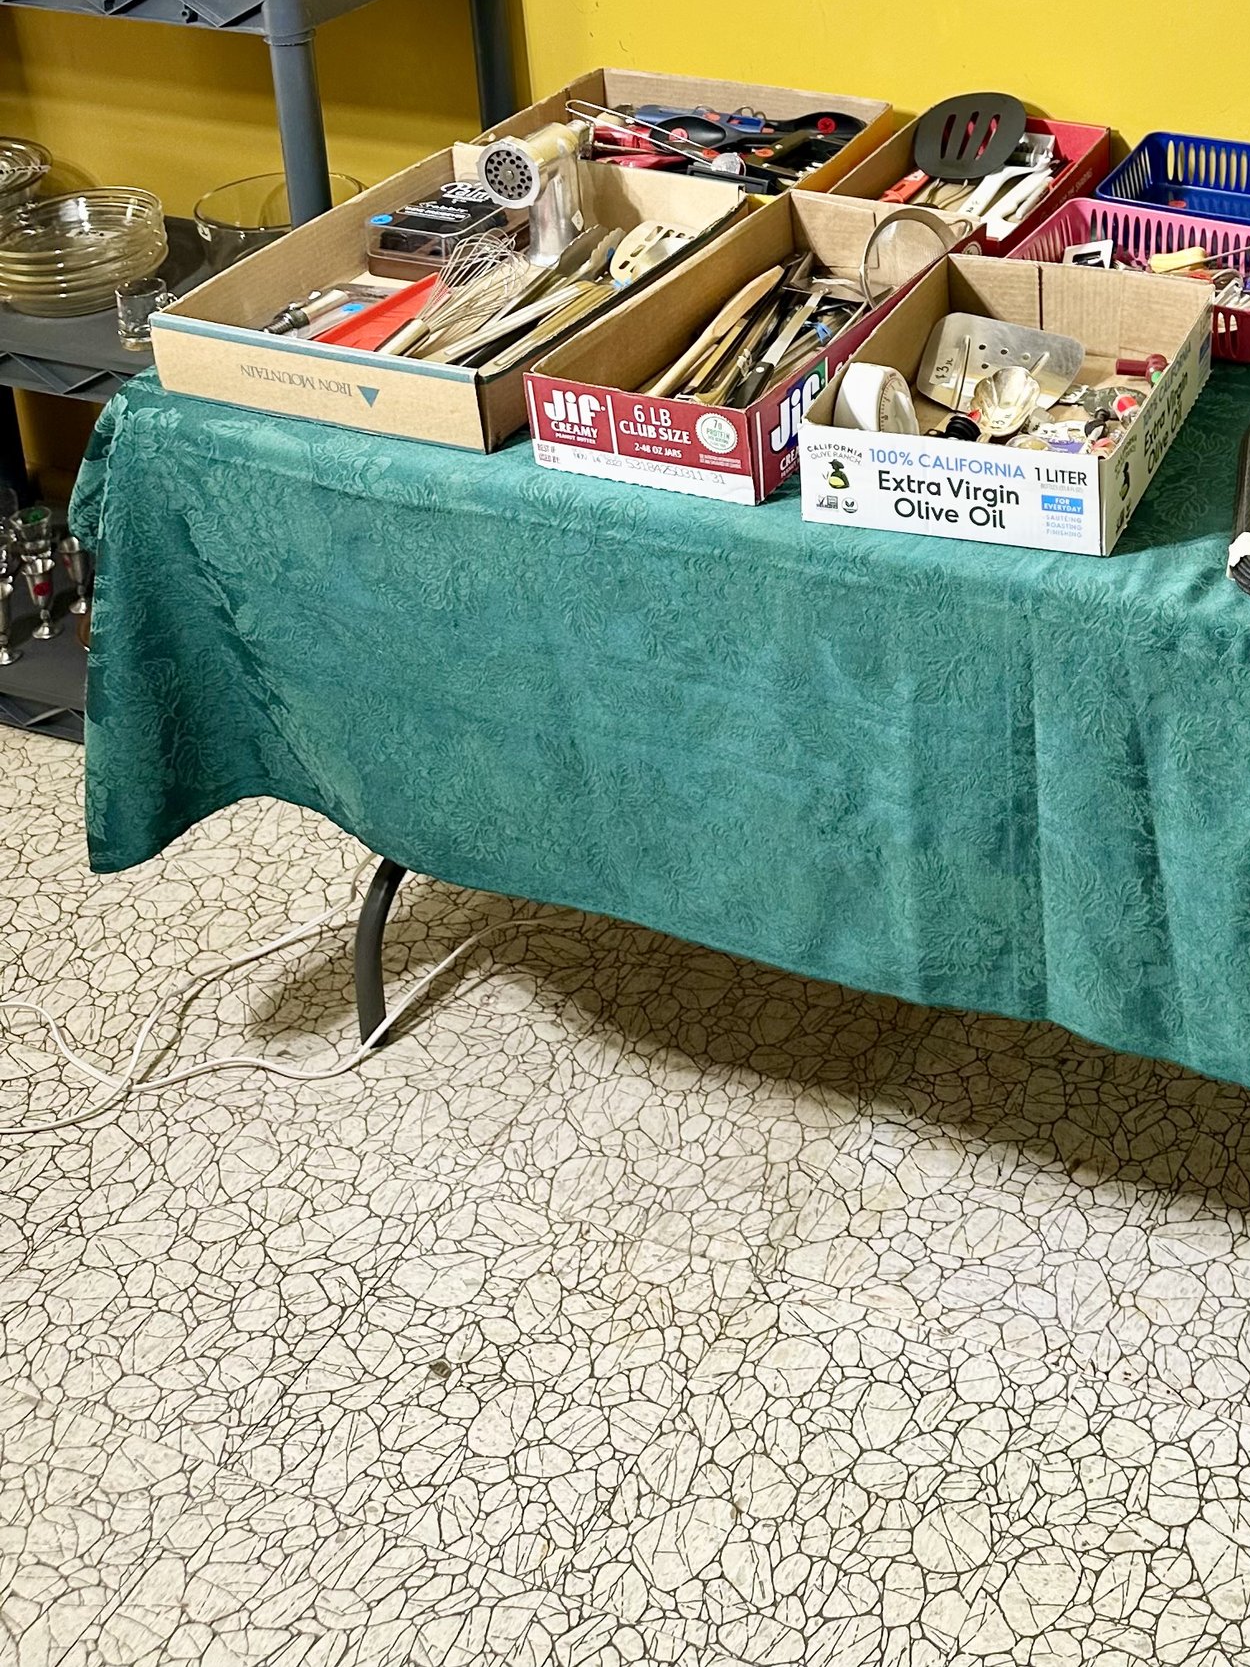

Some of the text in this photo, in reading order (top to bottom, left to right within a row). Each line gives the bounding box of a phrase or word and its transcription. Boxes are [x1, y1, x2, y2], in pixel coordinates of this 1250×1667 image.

[240, 364, 353, 397] IRON MOUNTAIN
[543, 389, 602, 427] Jif
[633, 404, 672, 427] 6 LB
[551, 421, 598, 439] CREAMY
[619, 420, 692, 444] CLUB SIZE
[634, 442, 682, 459] 2-48 OZ JARS
[807, 443, 862, 458] CALIFORNIA
[869, 448, 1026, 480] 100% CALIFORNIA
[1034, 466, 1088, 487] 1 LITER
[878, 469, 1020, 508] Extra Virgin
[1043, 502, 1083, 513] EVERYDAY
[1055, 497, 1071, 505] FOR
[894, 497, 1006, 529] Olive Oil
[1046, 521, 1082, 531] ROASTING
